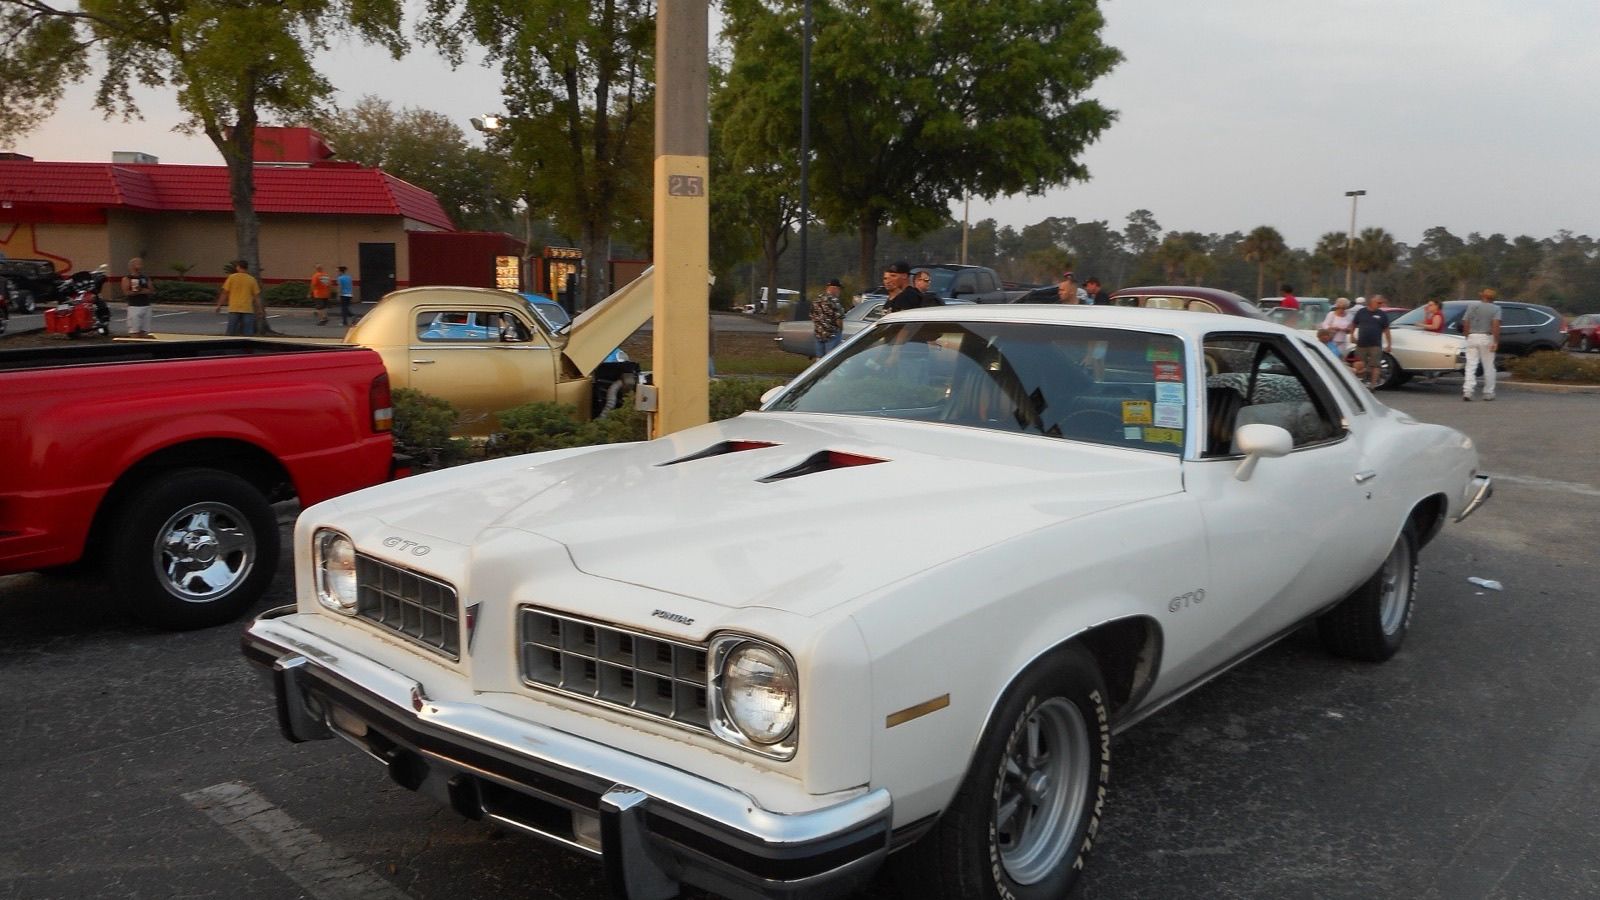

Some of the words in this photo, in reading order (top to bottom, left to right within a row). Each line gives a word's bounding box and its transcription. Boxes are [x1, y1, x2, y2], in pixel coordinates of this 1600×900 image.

[671, 176, 699, 196] 25
[383, 536, 432, 556] GTO
[1168, 588, 1206, 613] GTO
[651, 609, 695, 625] PONTIAC
[1073, 690, 1110, 871] PRIMEWELL
